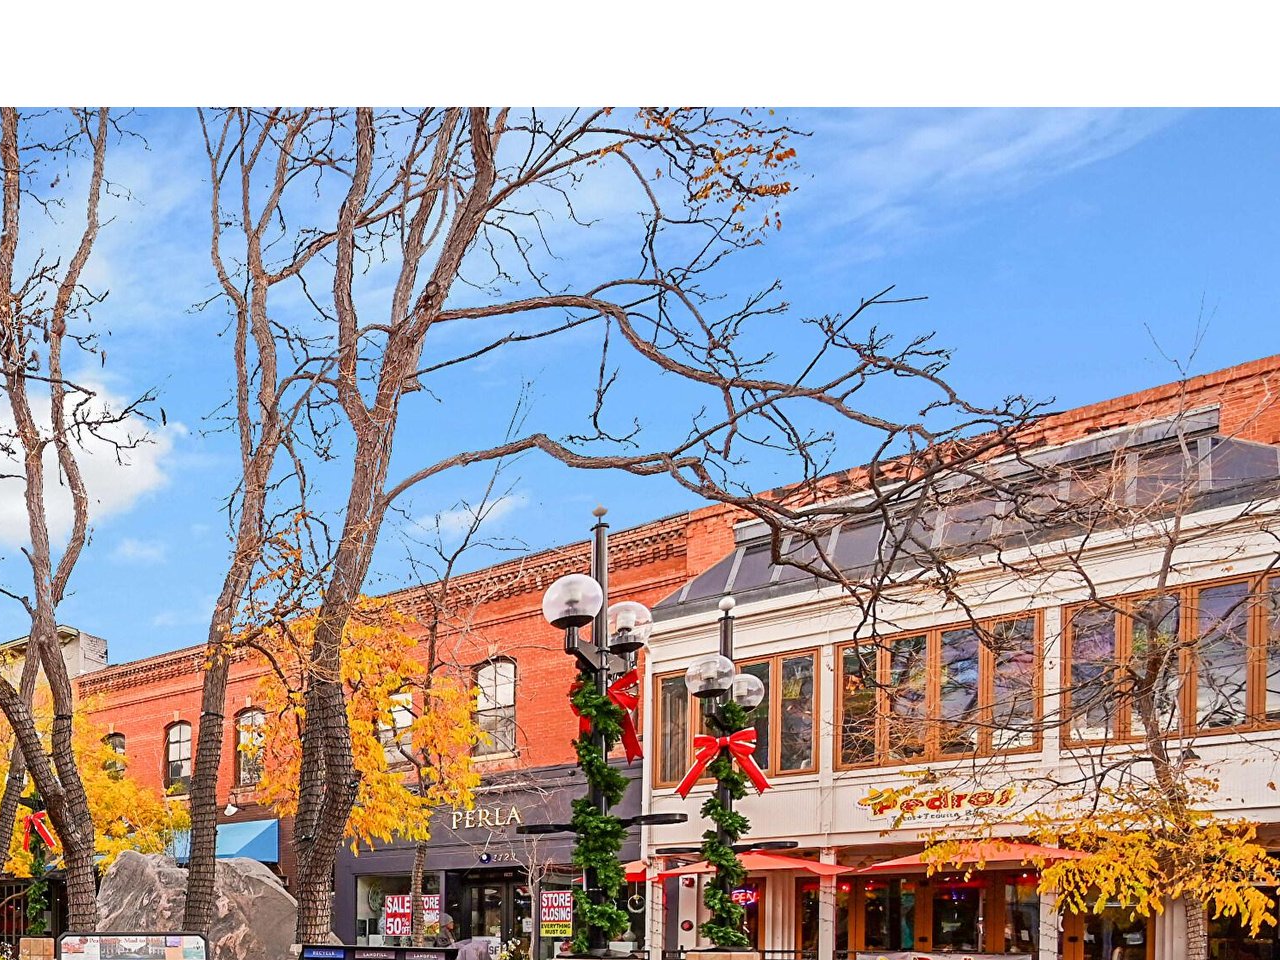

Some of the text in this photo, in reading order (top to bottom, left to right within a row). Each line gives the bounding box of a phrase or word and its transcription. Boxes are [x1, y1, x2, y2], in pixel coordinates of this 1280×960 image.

[451, 806, 521, 830] PERLA
[387, 896, 411, 913] SALE
[542, 893, 571, 907] STORE
[732, 892, 756, 904] PEN
[542, 907, 571, 921] CLOSING
[386, 917, 410, 934] 50%
[402, 926, 410, 934] OFF
